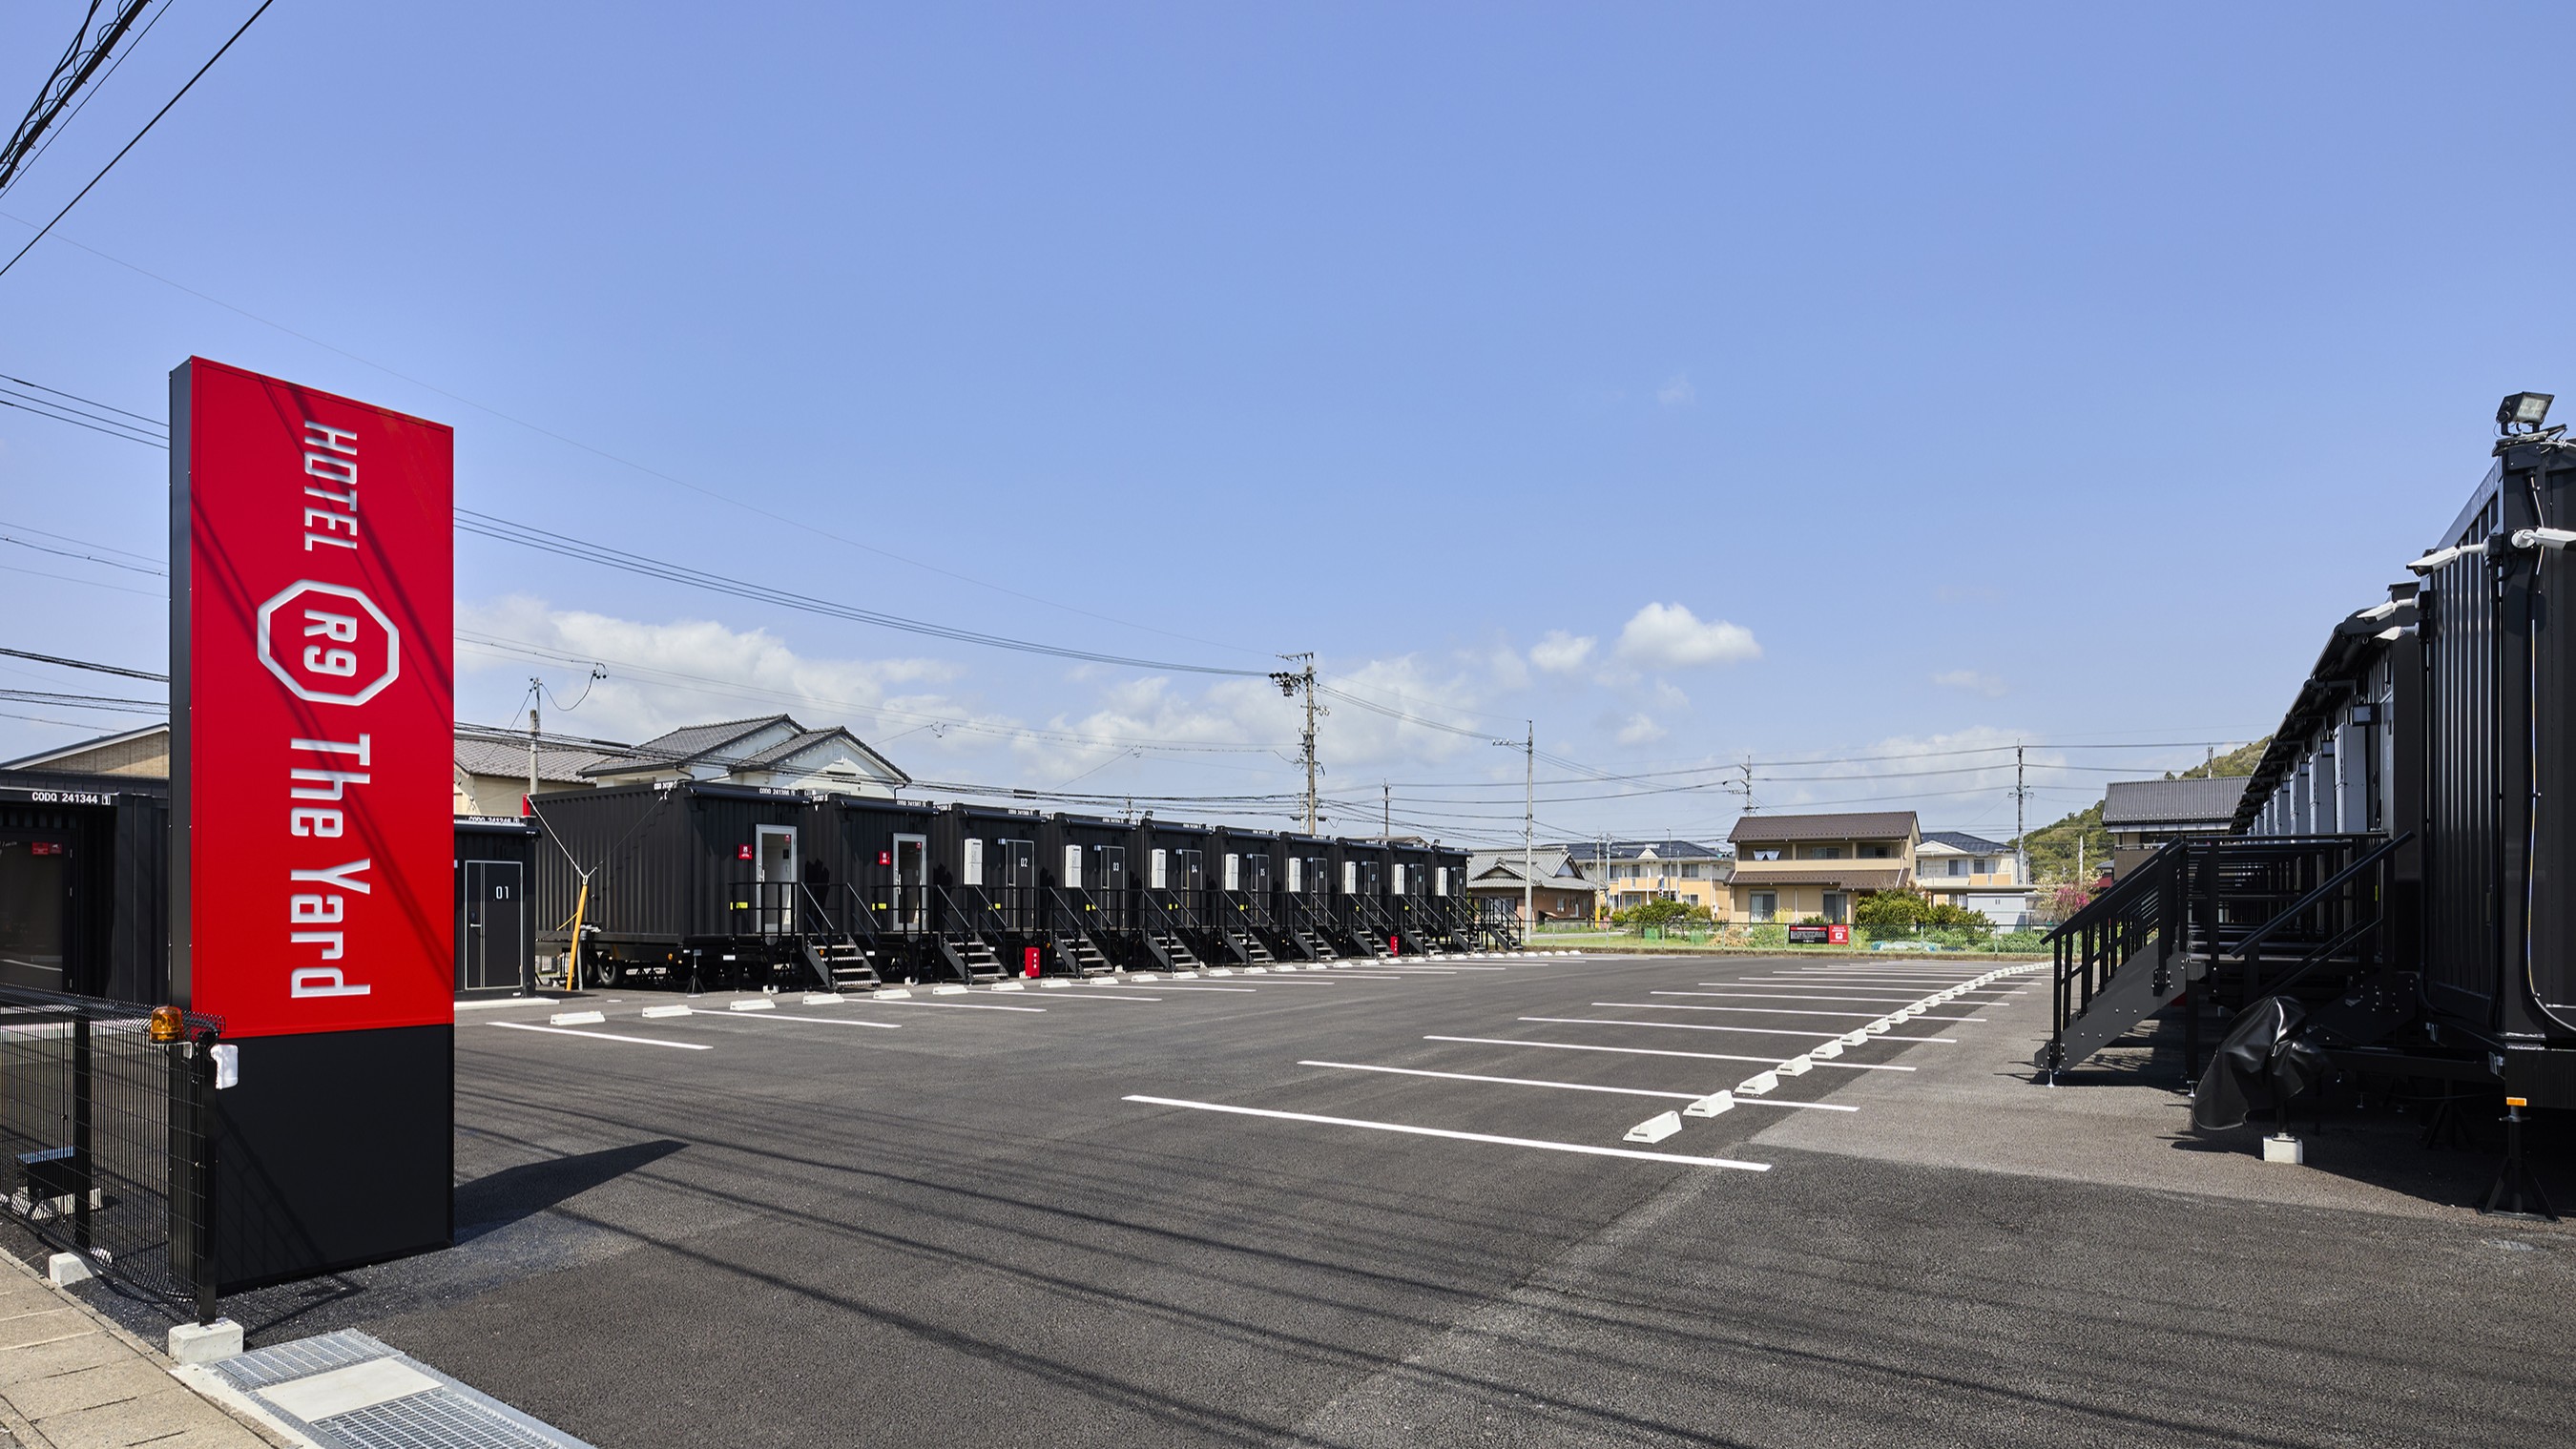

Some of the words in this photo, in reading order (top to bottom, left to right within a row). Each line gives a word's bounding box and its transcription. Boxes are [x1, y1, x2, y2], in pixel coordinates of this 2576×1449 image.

[304, 421, 358, 552] HOTEL
[303, 610, 358, 678] R9
[61, 793, 98, 803] 241344
[290, 733, 372, 838] The
[495, 885, 509, 900] 01
[1020, 857, 1028, 868] 02
[290, 858, 372, 999] Yard
